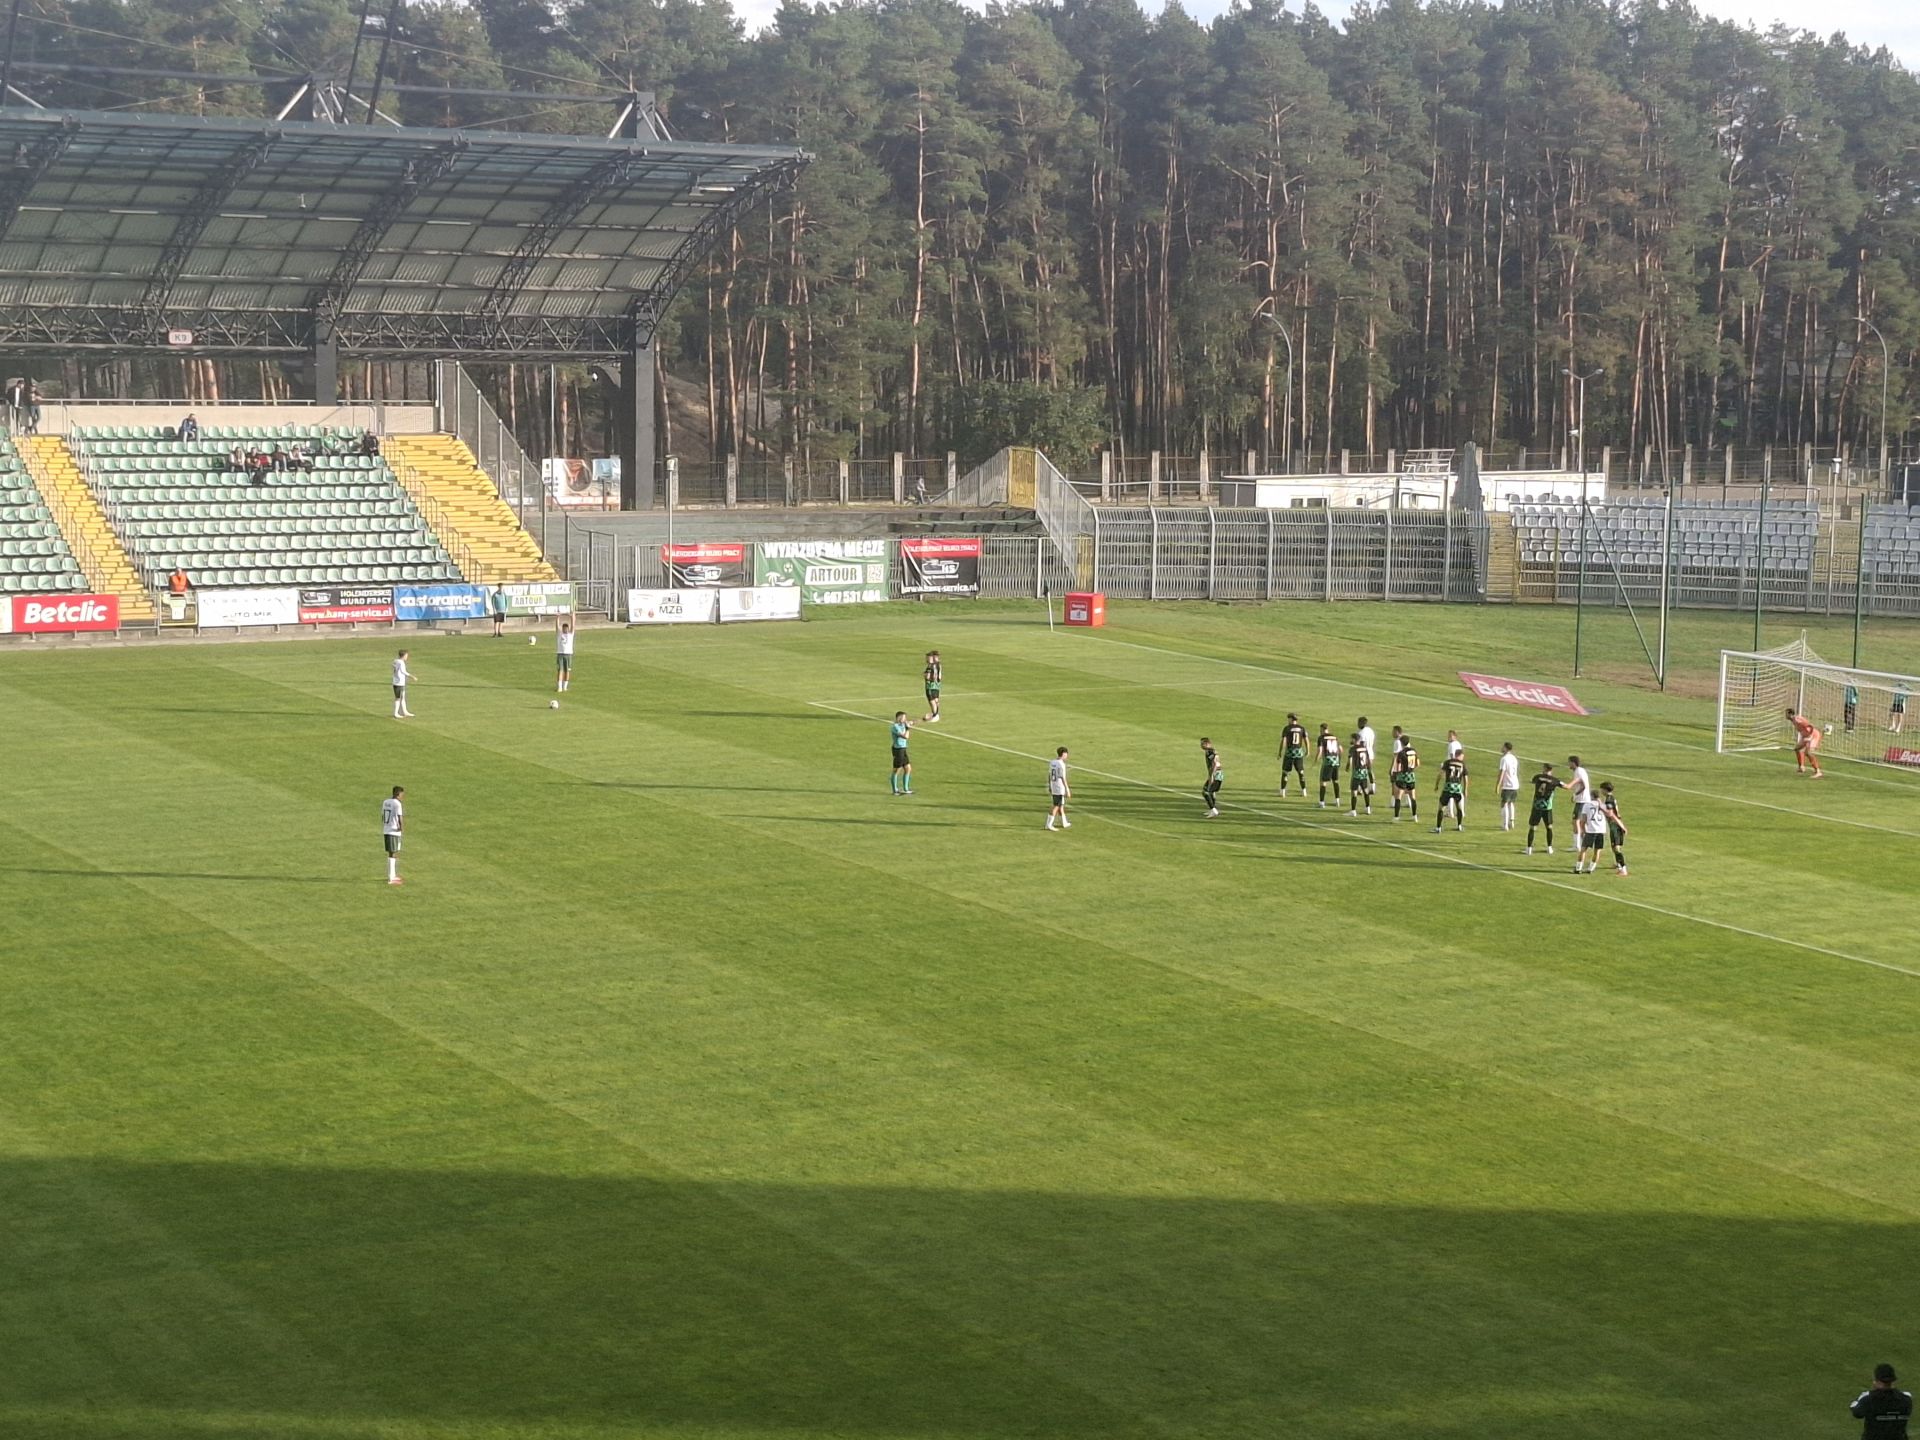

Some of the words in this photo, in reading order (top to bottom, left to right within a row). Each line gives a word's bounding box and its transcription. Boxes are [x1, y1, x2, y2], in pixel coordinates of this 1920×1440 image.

[844, 540, 884, 556] MECZE
[810, 567, 857, 582] ARTOUR
[399, 595, 472, 607] castorama
[24, 600, 108, 624] Betclic
[659, 605, 683, 614] MZB
[1471, 679, 1568, 707] Betclic
